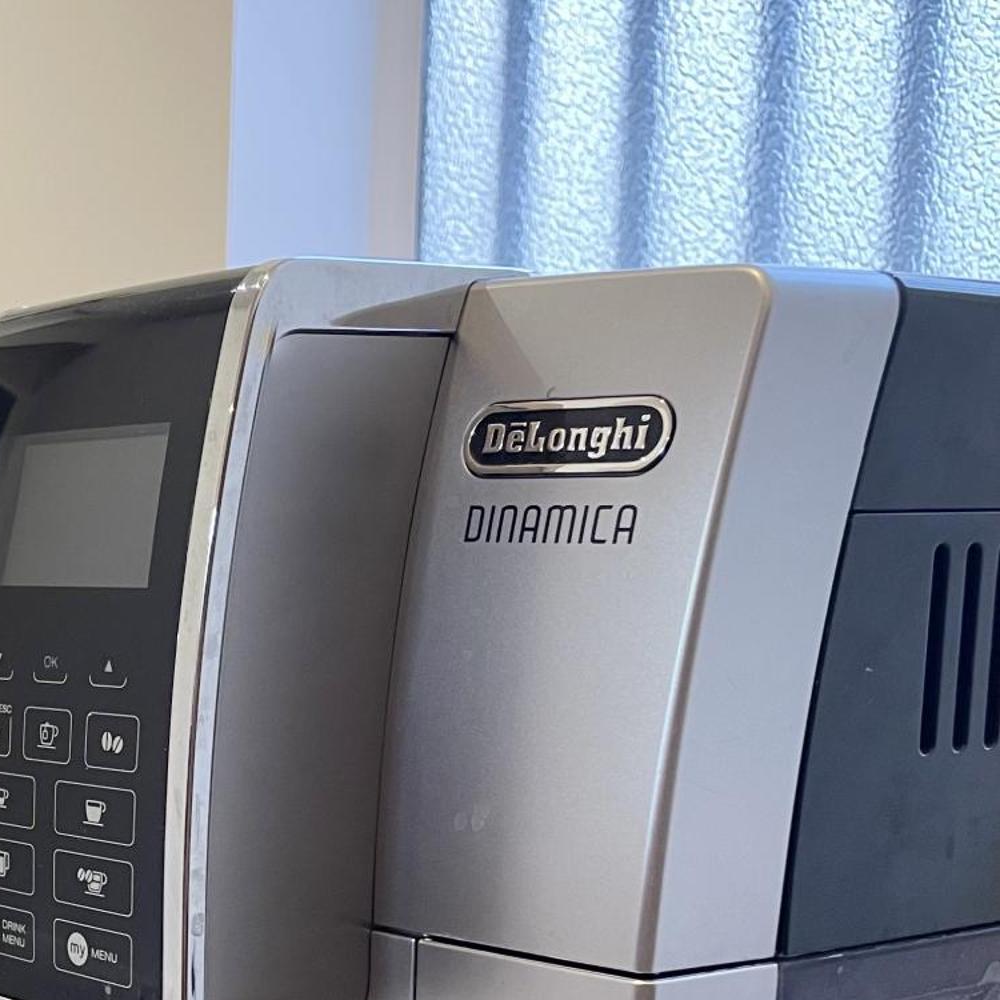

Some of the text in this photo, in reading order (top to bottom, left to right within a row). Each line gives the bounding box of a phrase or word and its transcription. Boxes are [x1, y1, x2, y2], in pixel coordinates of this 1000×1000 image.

[463, 504, 639, 545] DINAMICA
[43, 655, 59, 669] OK
[2, 919, 26, 934] DRINK
[2, 933, 26, 948] MENU
[70, 942, 118, 964] my MENU
